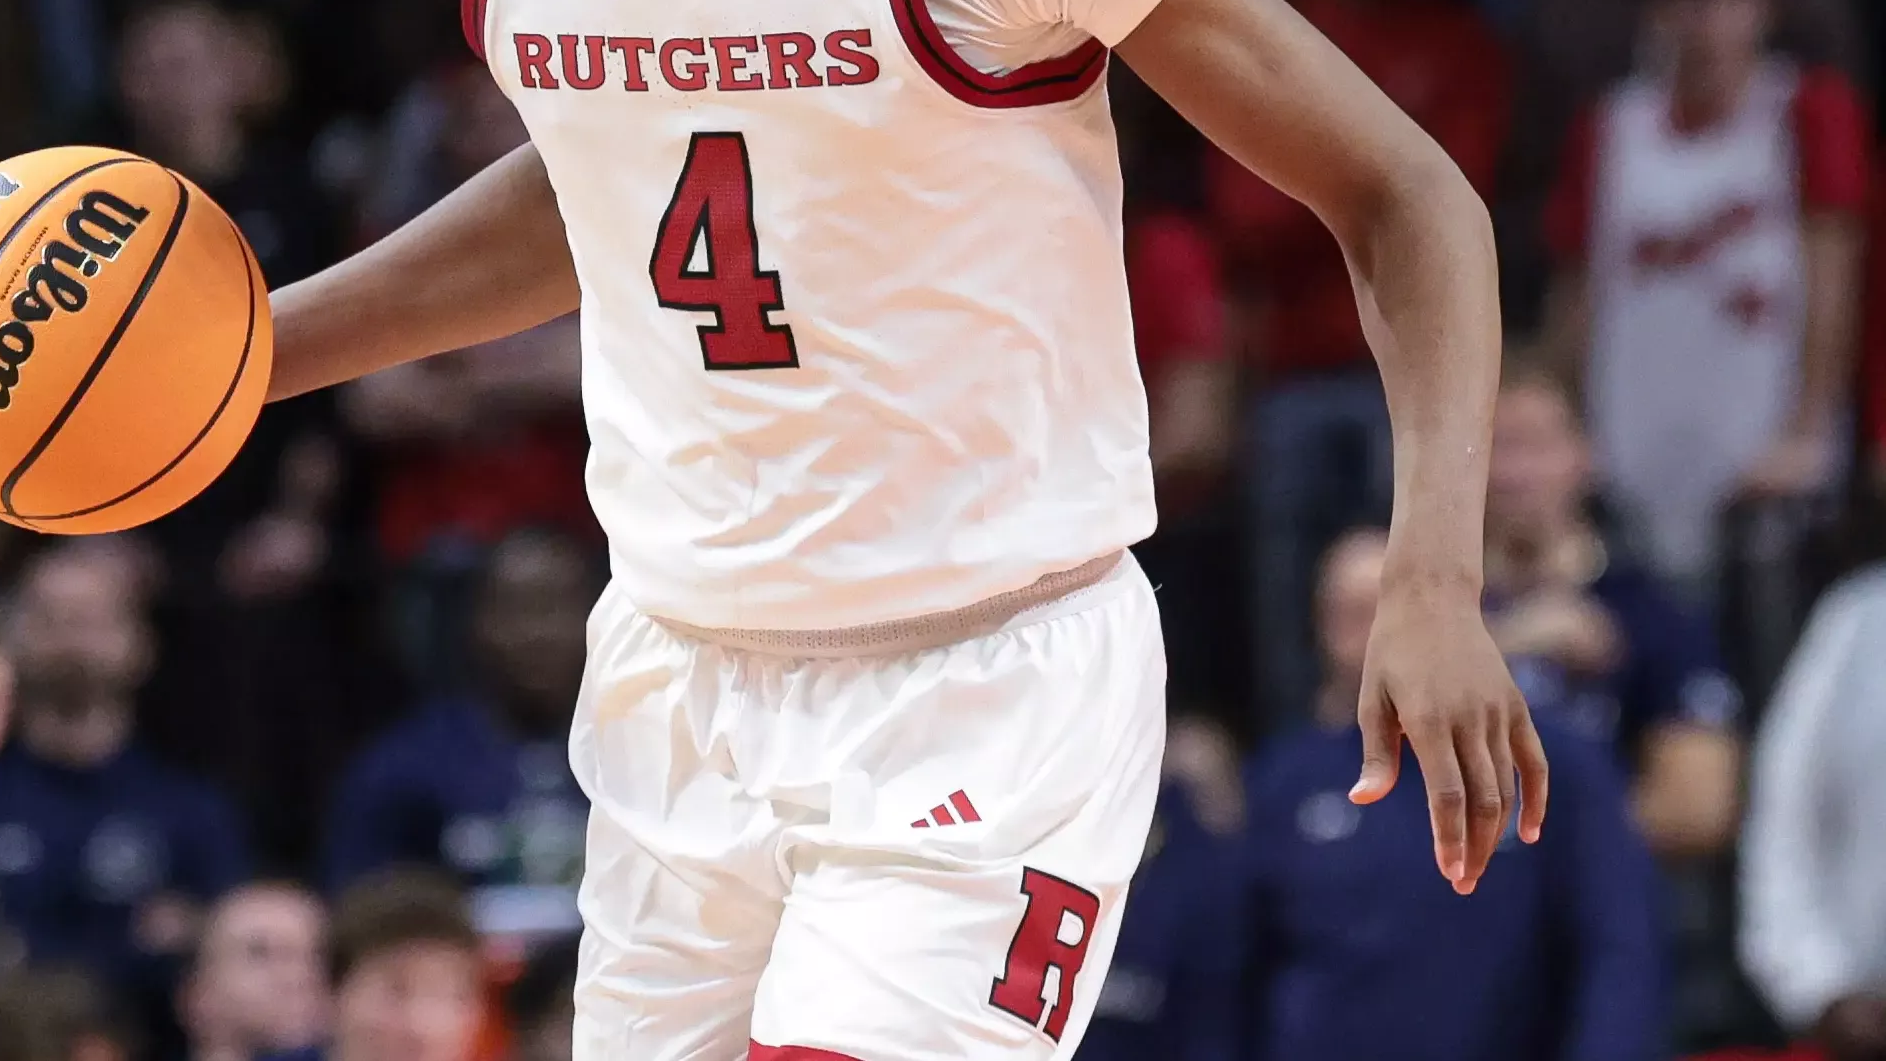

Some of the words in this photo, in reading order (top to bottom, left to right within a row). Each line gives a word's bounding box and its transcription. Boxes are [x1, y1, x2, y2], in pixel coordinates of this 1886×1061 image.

[513, 28, 881, 93] RUTGERS
[19, 226, 49, 267] INDOOR
[649, 130, 800, 372] 4
[988, 865, 1101, 1046] R
